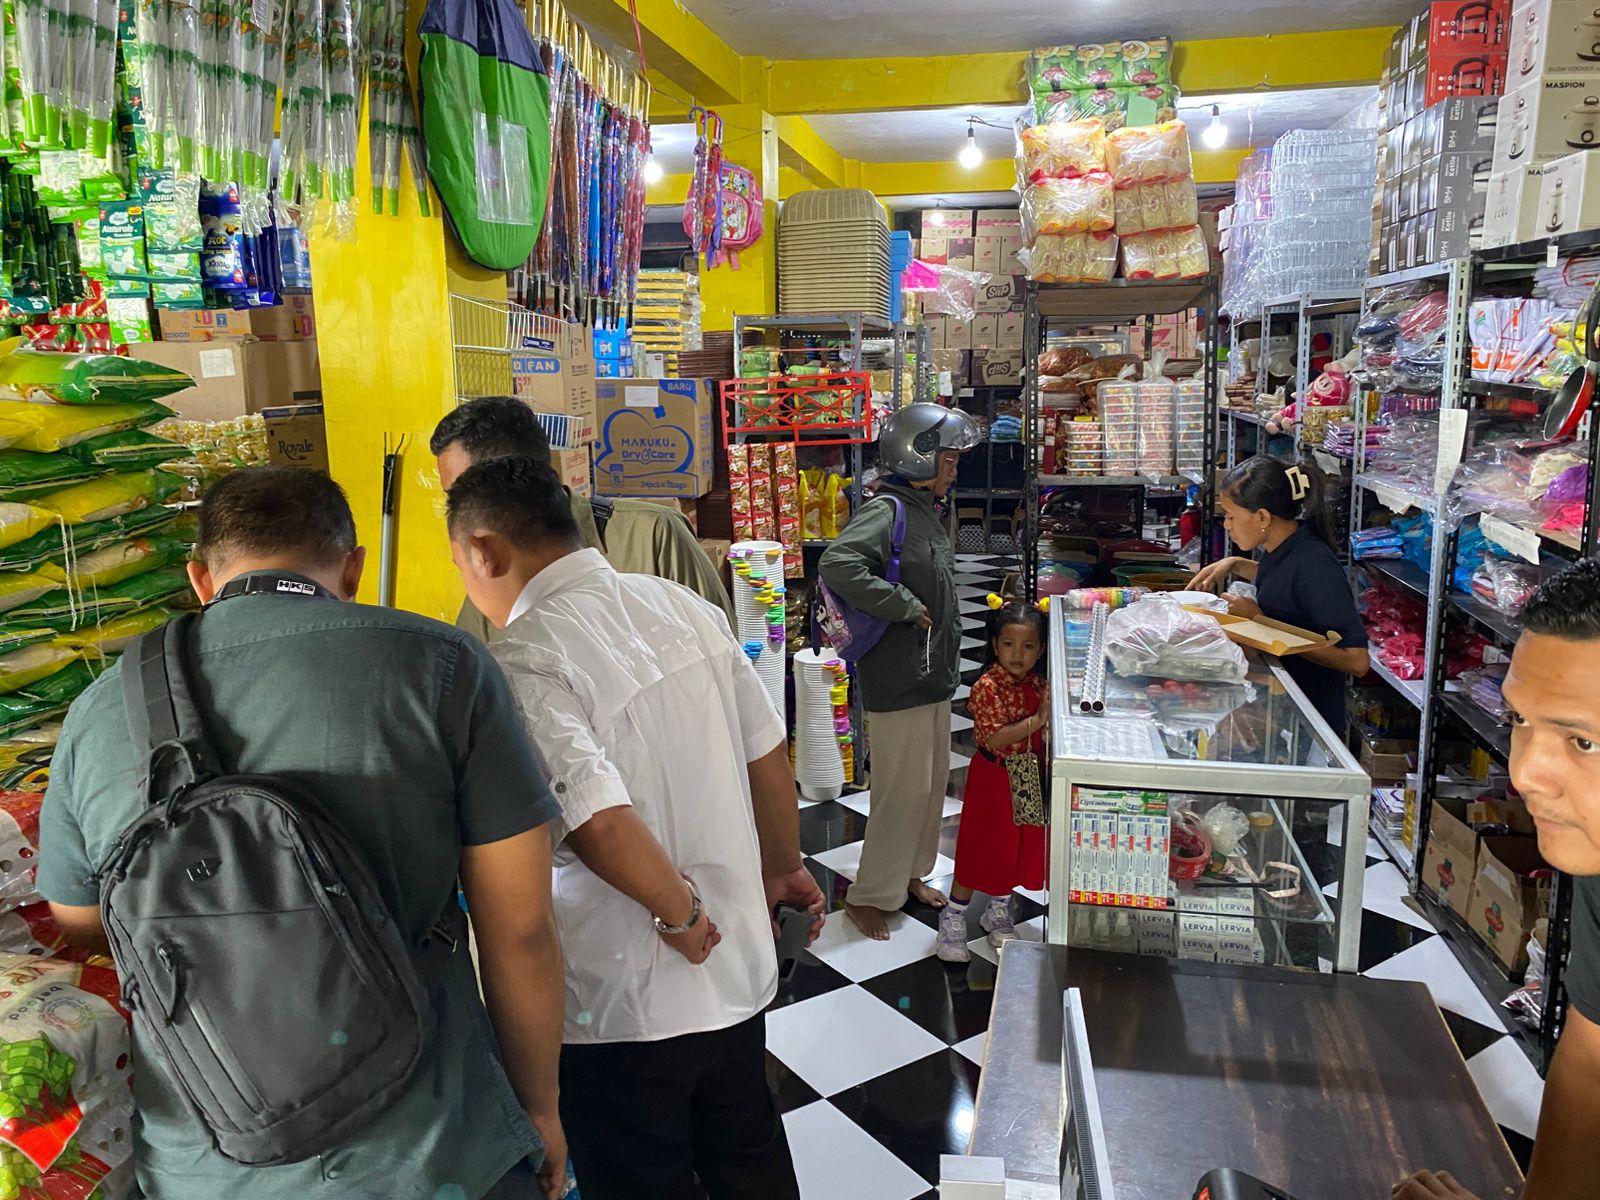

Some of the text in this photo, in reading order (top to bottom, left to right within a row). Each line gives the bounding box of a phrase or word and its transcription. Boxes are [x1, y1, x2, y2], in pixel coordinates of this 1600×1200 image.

[1545, 81, 1585, 89] MASPION
[527, 361, 555, 371] FAN
[278, 439, 314, 460] Royale
[622, 450, 640, 460] Dry
[651, 450, 675, 459] Care
[276, 580, 316, 595] HKS
[1183, 902, 1251, 912] LERVIA LERVIA
[1142, 915, 1171, 923] LERVIA
[1183, 923, 1251, 933] LERVIA LERVIA
[1182, 940, 1250, 951] LERVIA LERVIA
